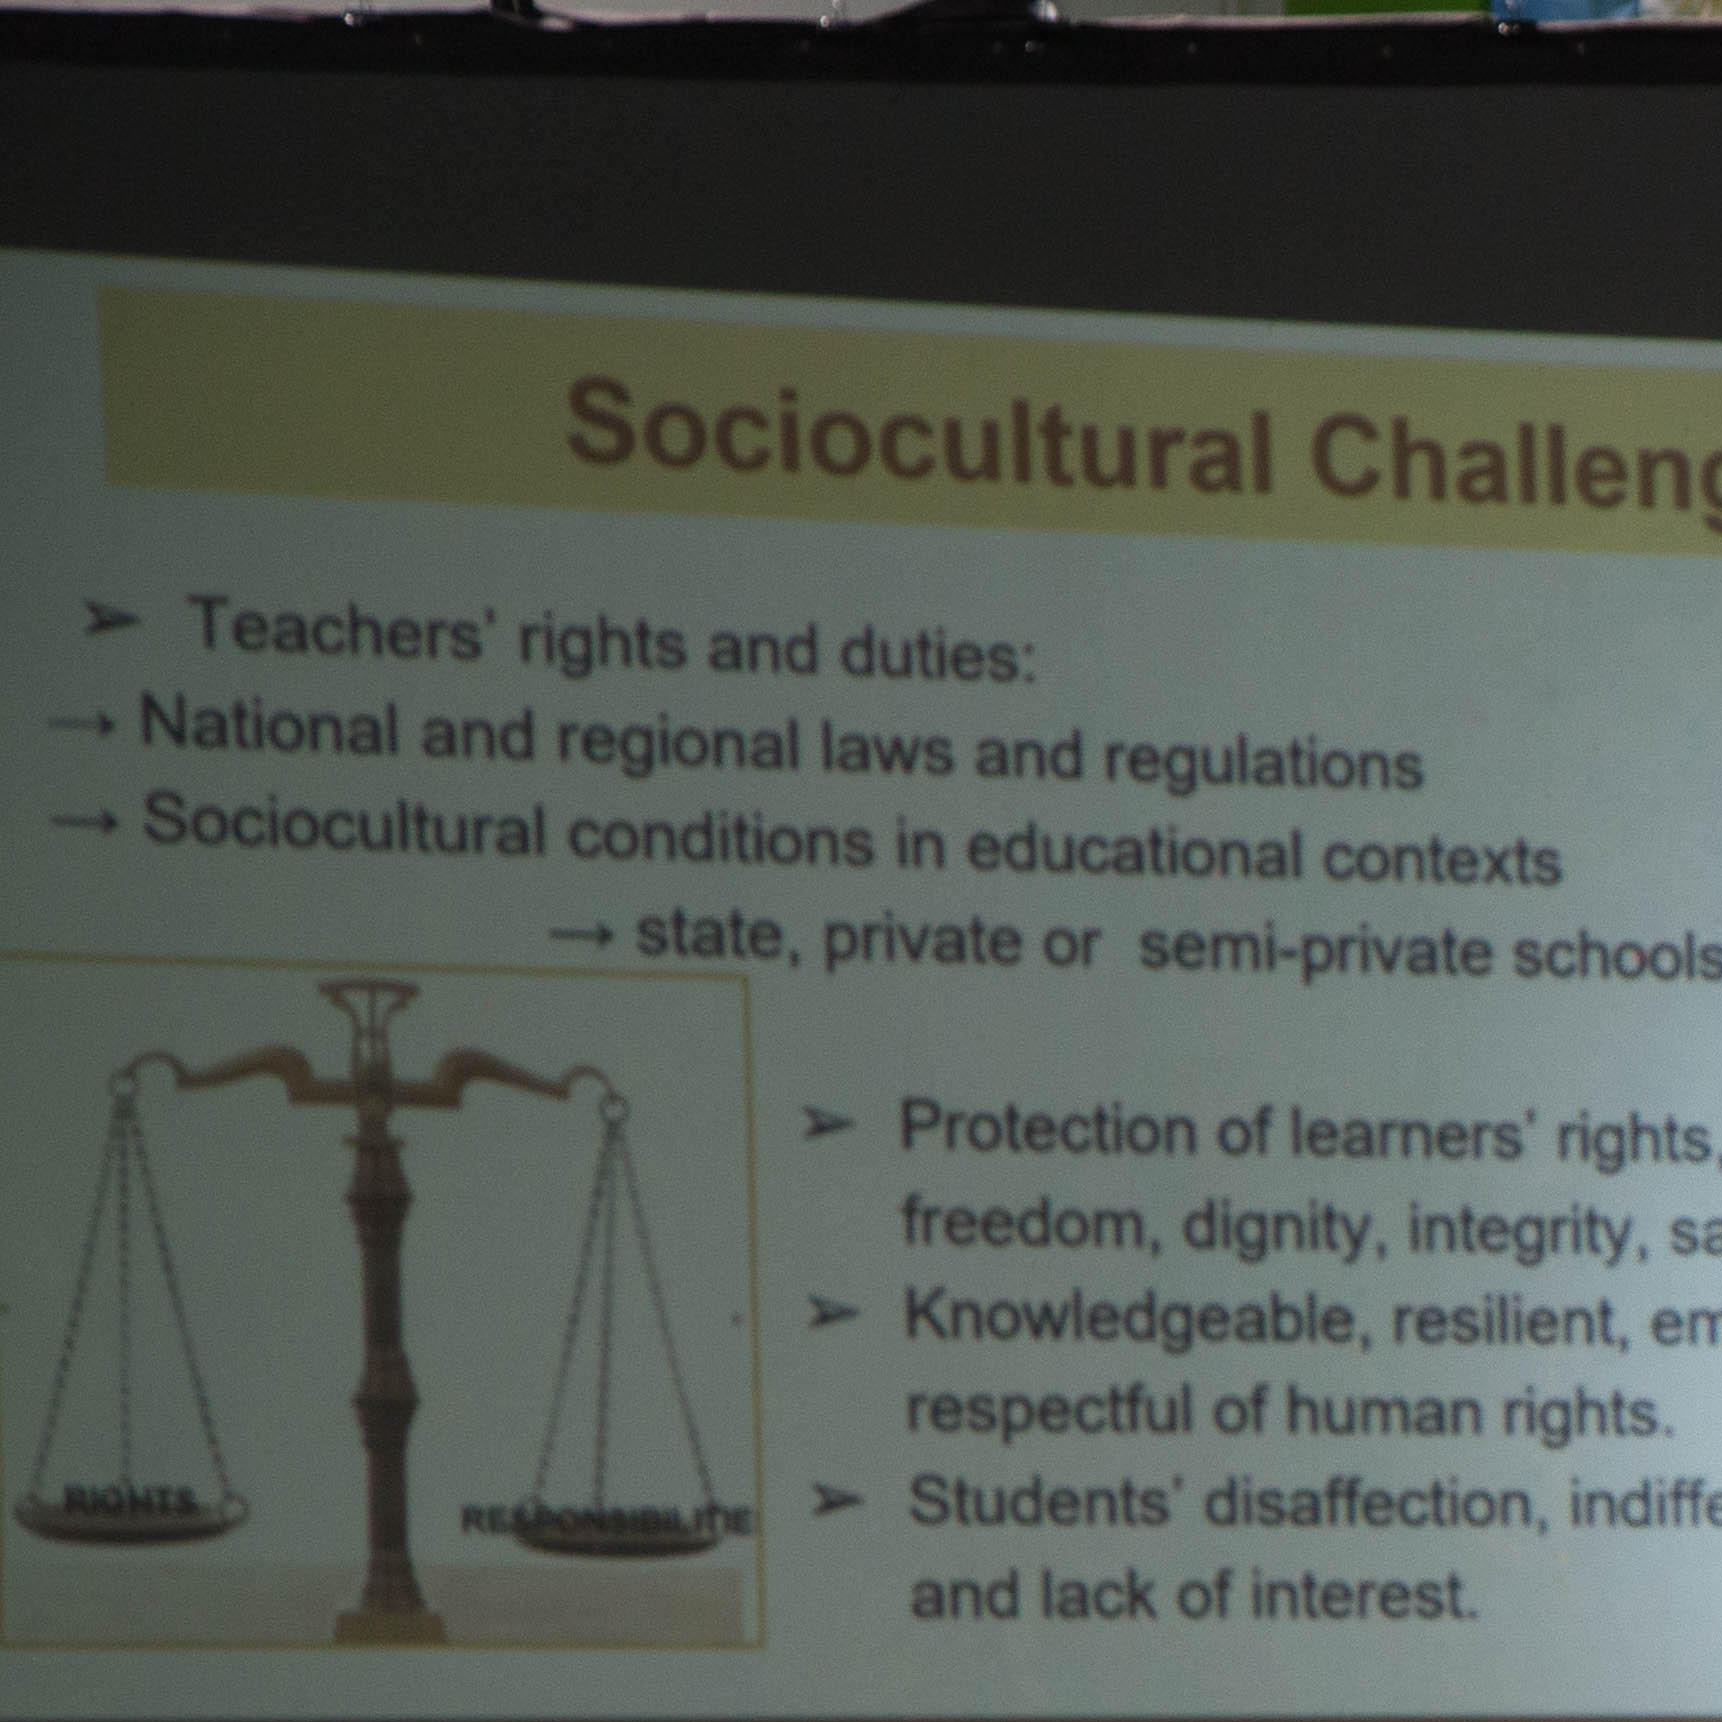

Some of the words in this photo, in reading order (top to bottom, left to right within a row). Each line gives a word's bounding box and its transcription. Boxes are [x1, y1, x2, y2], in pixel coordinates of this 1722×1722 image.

[567, 376, 1274, 496] Sociocultural
[189, 593, 496, 663] Teachers'
[518, 615, 689, 680] rights
[707, 622, 821, 677] and
[838, 625, 1036, 685] duties:
[140, 691, 400, 759] National
[421, 708, 537, 763] and
[556, 719, 802, 779] regional
[820, 720, 957, 778] laws
[973, 728, 1086, 782] and
[1103, 733, 1427, 798] regulations
[144, 789, 548, 860] Sociocultural
[566, 813, 877, 870] conditions
[894, 826, 947, 870] in
[964, 822, 1304, 881] educational
[1322, 837, 1564, 890] contexts
[636, 908, 801, 967] state,
[823, 917, 1024, 973] private
[1041, 927, 1101, 969] or
[1138, 928, 1496, 986] semi-private
[899, 1095, 1198, 1156] Protection
[1215, 1103, 1274, 1158] of
[1289, 1106, 1536, 1162] learners'
[900, 1192, 1161, 1255] freedom,
[1182, 1199, 1387, 1265] dignity,
[1408, 1203, 1649, 1268] integrity,
[904, 1287, 1372, 1353] Knowledgeable,
[1392, 1297, 1630, 1352] resilient,
[906, 1384, 1194, 1442] respectful
[1211, 1383, 1269, 1436] of
[1285, 1385, 1484, 1437] human
[1502, 1389, 1676, 1450] rights.
[63, 1485, 198, 1516] RIGHTS
[909, 1472, 1182, 1528] Students'
[1203, 1476, 1549, 1536] disaffection,
[910, 1571, 1021, 1621] and
[1040, 1569, 1158, 1621] lack
[1175, 1567, 1233, 1621] of
[1251, 1573, 1480, 1622] interest.
